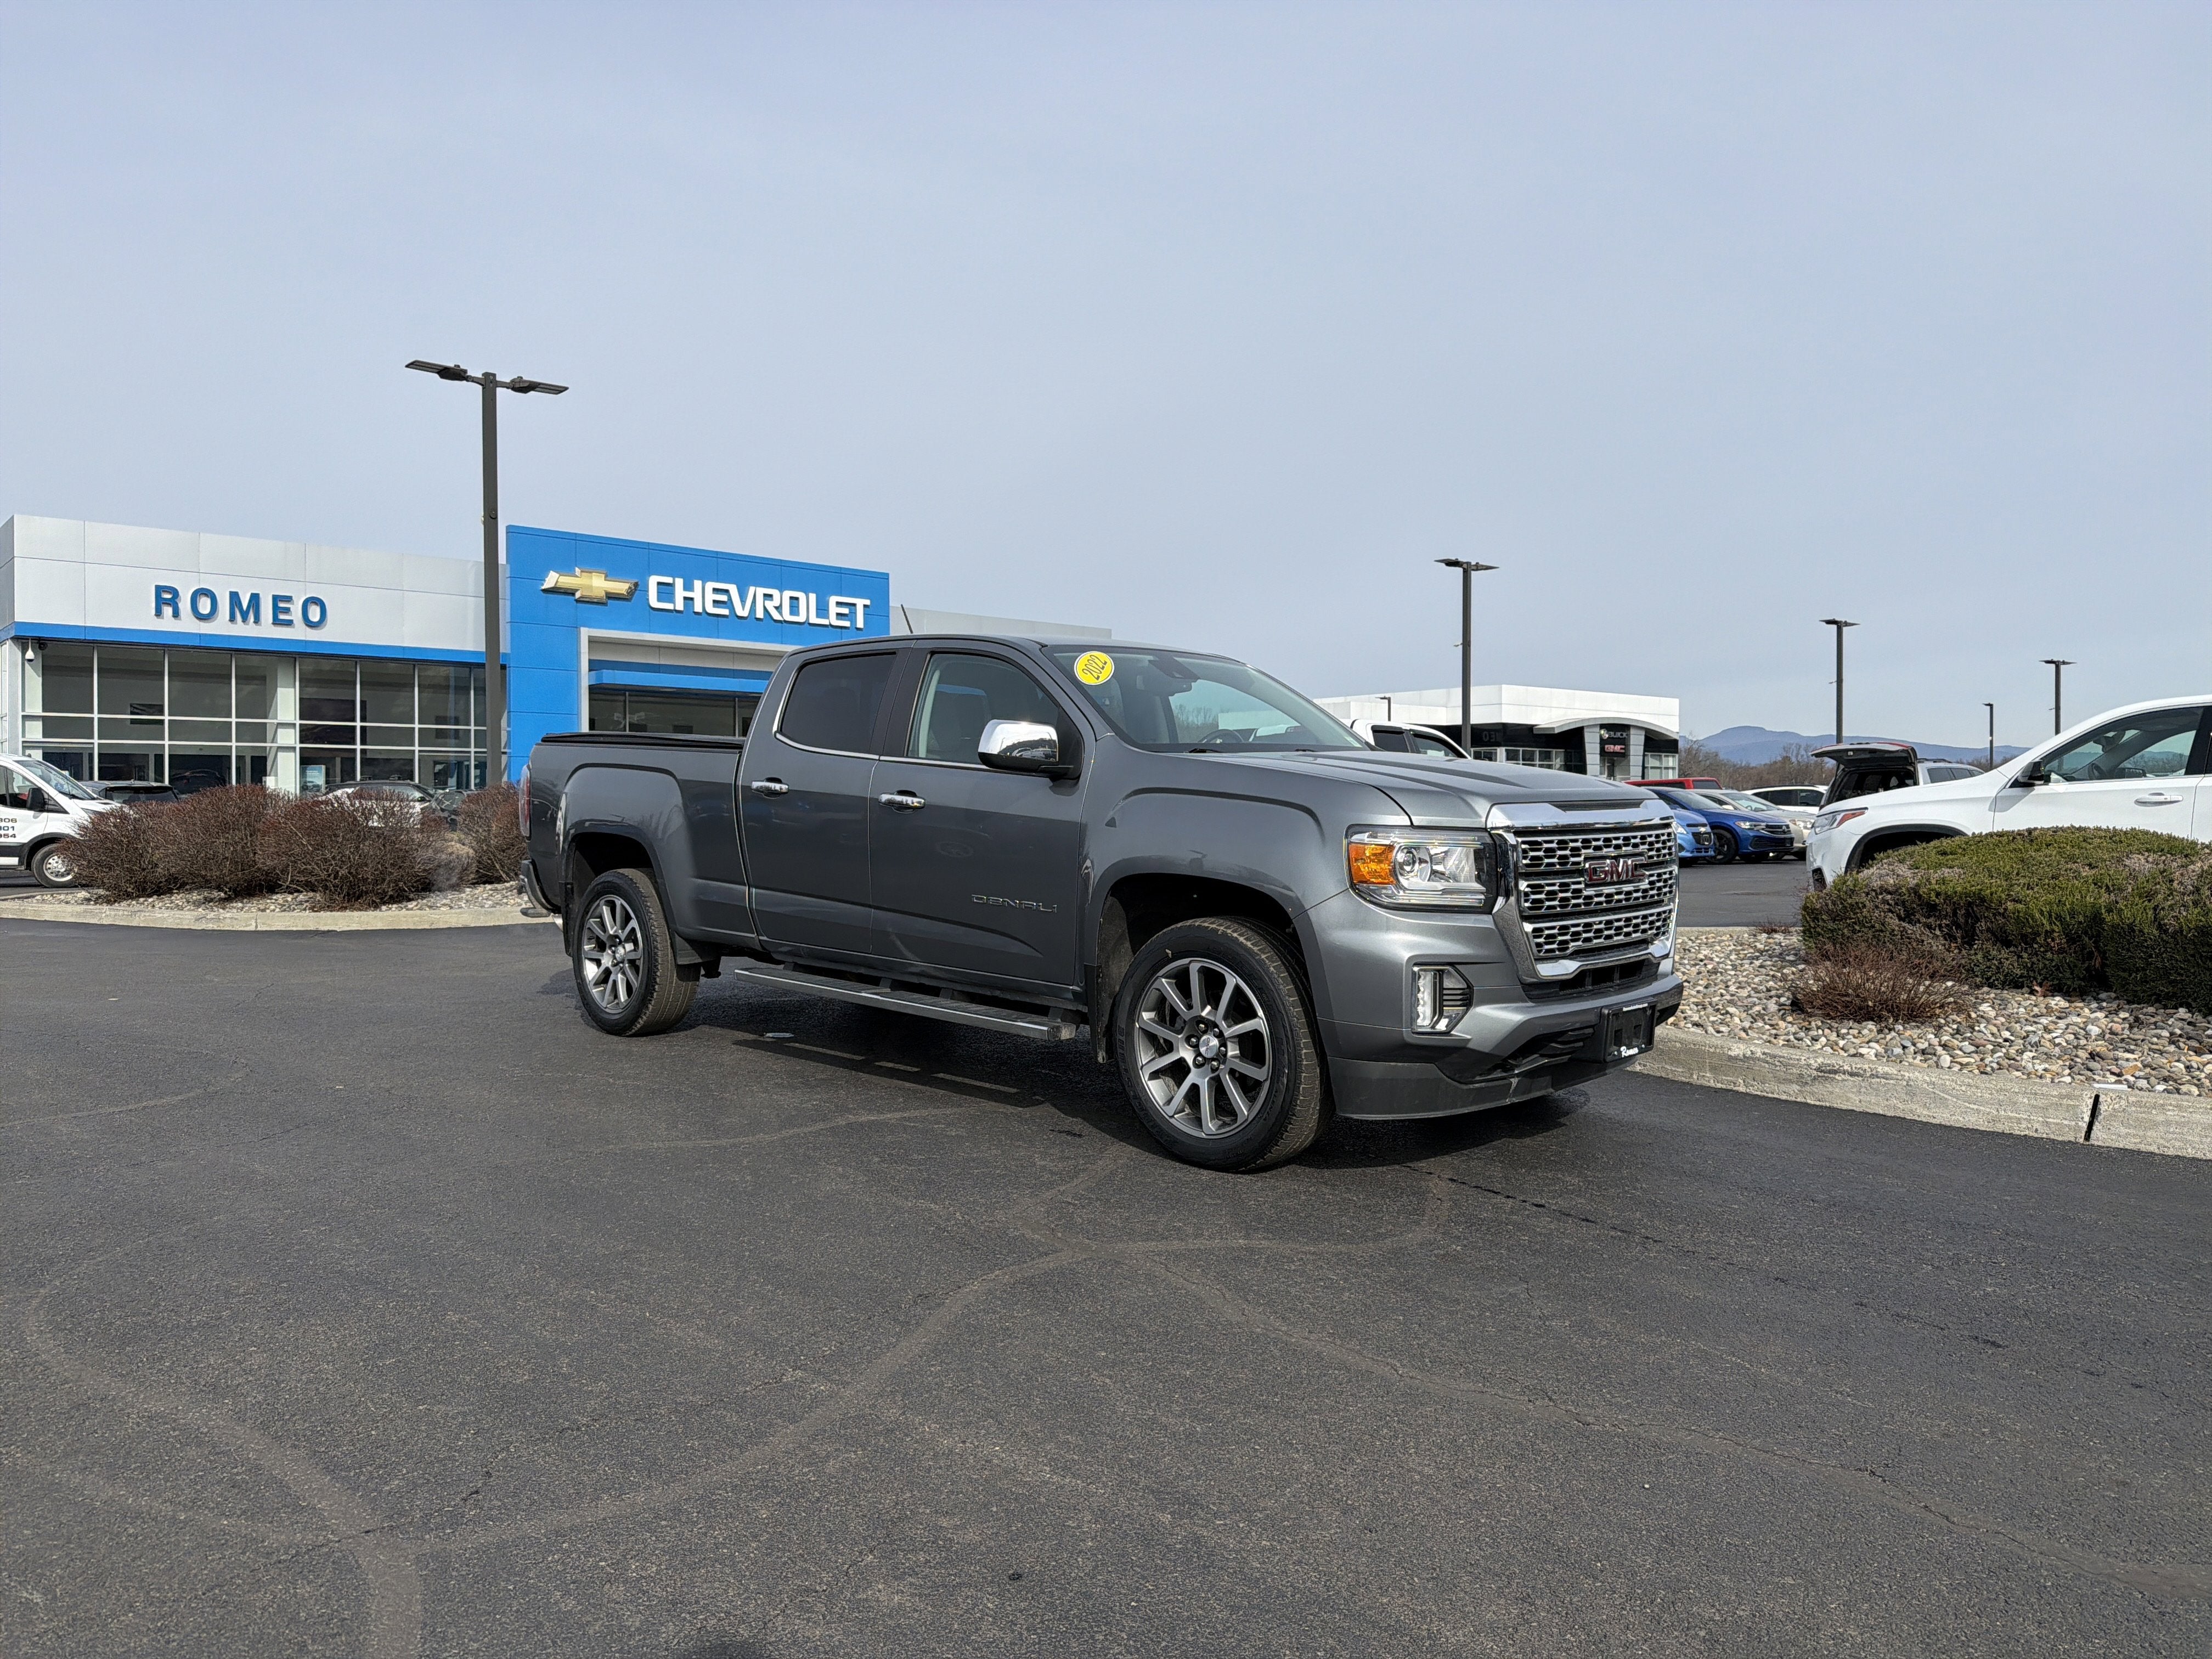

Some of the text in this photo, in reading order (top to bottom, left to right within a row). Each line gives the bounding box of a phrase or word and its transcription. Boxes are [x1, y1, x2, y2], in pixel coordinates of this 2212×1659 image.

[154, 584, 327, 628] ROMEO
[648, 575, 871, 631] CHEVROLET
[1082, 654, 1108, 681] 2022
[1605, 744, 1626, 753] GMC
[1585, 856, 1647, 884] GMC
[971, 894, 1058, 913] DENALI
